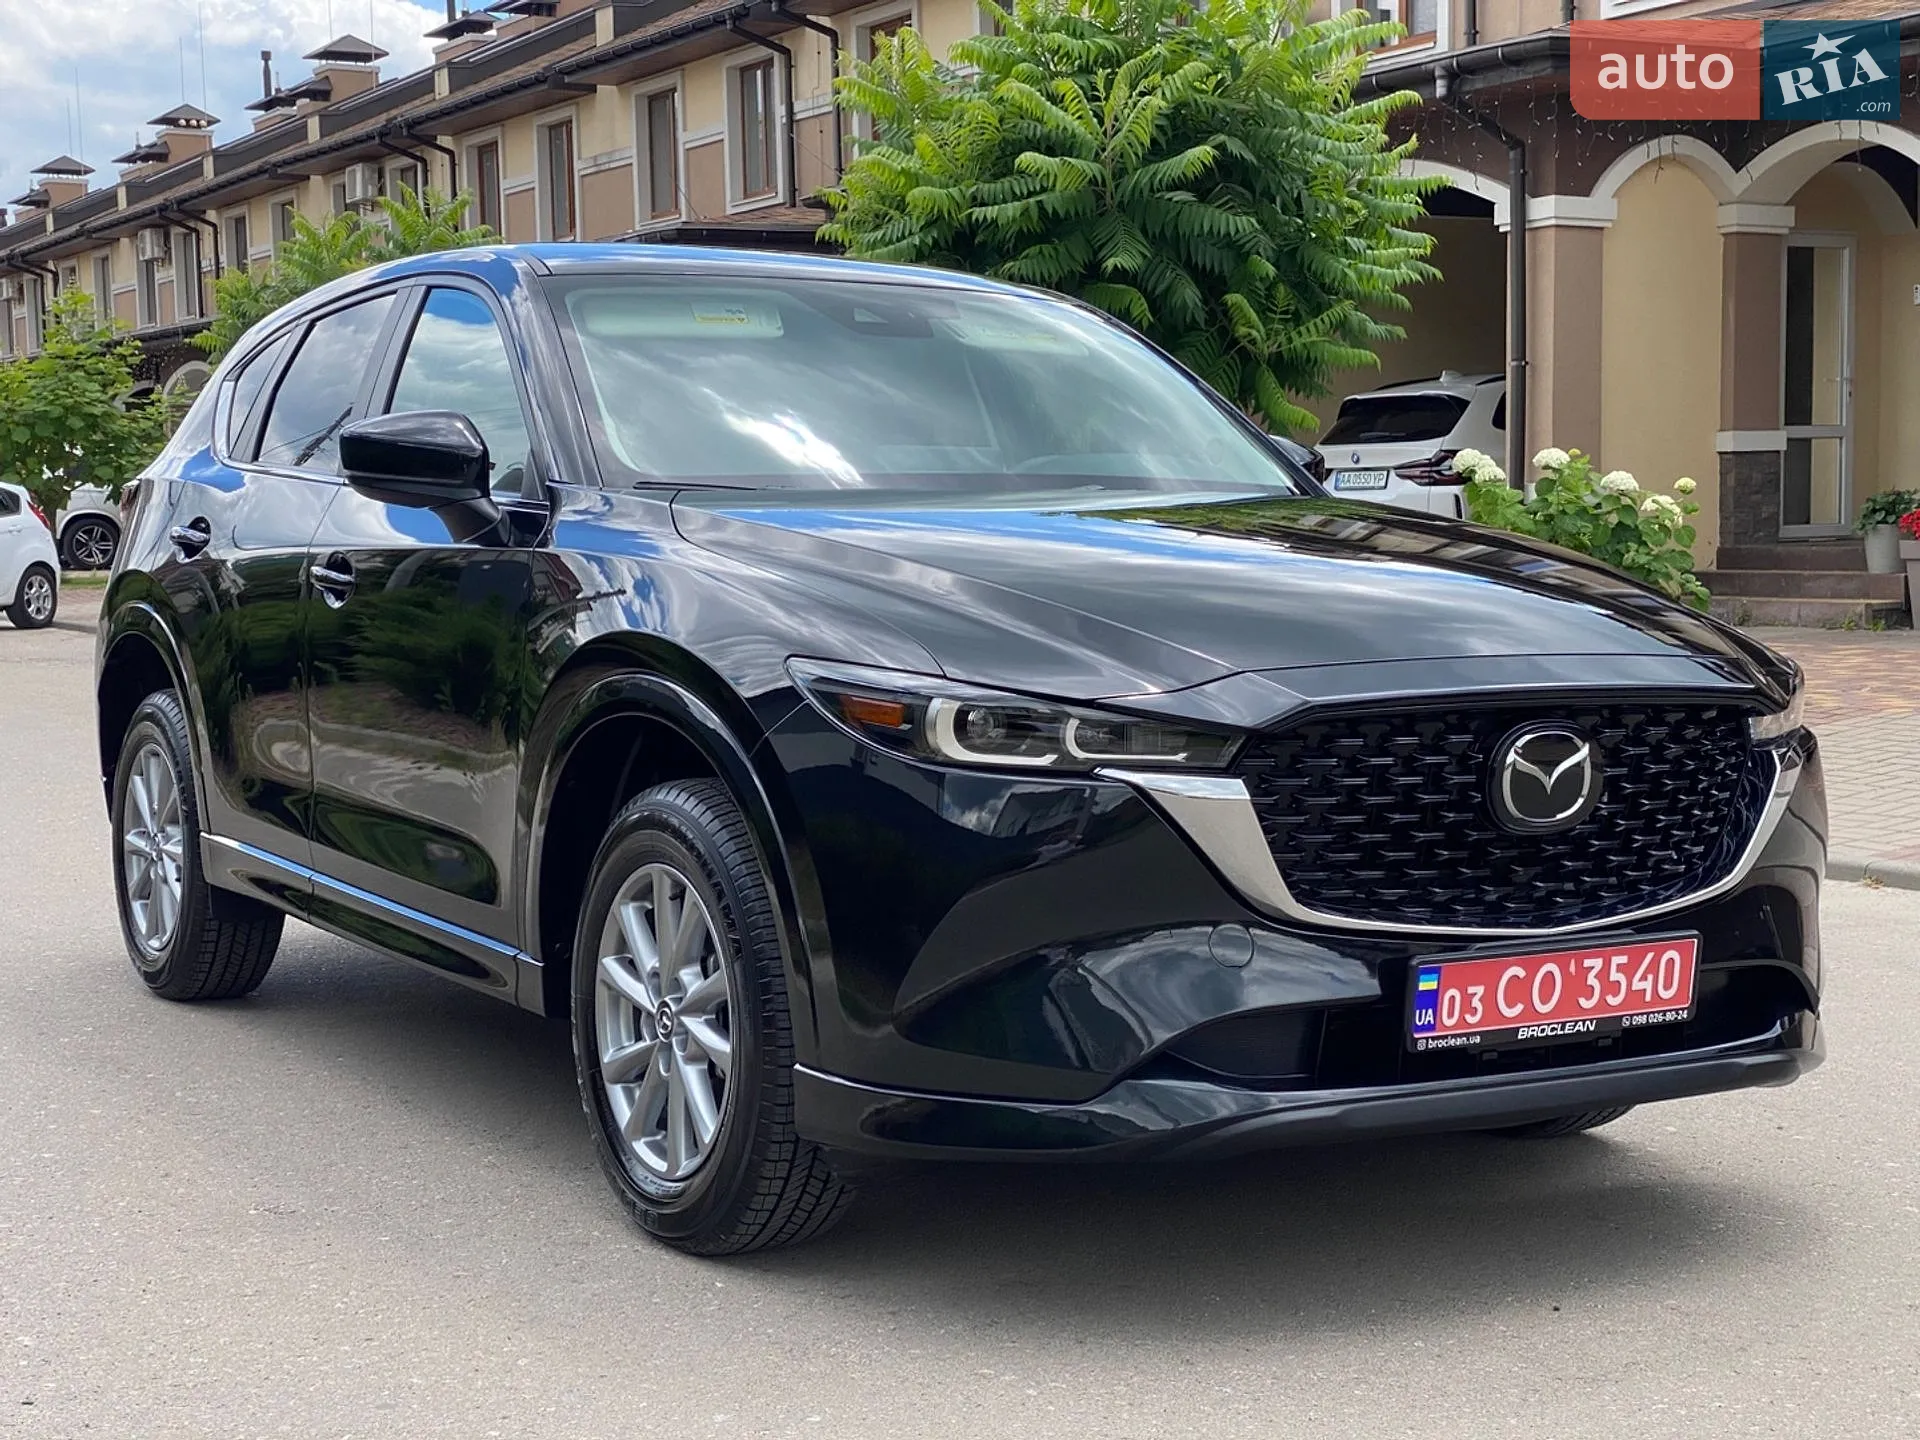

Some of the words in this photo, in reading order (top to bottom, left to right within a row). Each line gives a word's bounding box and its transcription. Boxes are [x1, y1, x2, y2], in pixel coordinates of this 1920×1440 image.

[1441, 985, 1485, 1027] 03
[1496, 962, 1563, 1018] CO
[1577, 950, 1681, 1009] 3540
[1415, 1008, 1434, 1026] UA
[1517, 1020, 1597, 1040] BROCLEAN
[1428, 1036, 1481, 1049] broclean.ua
